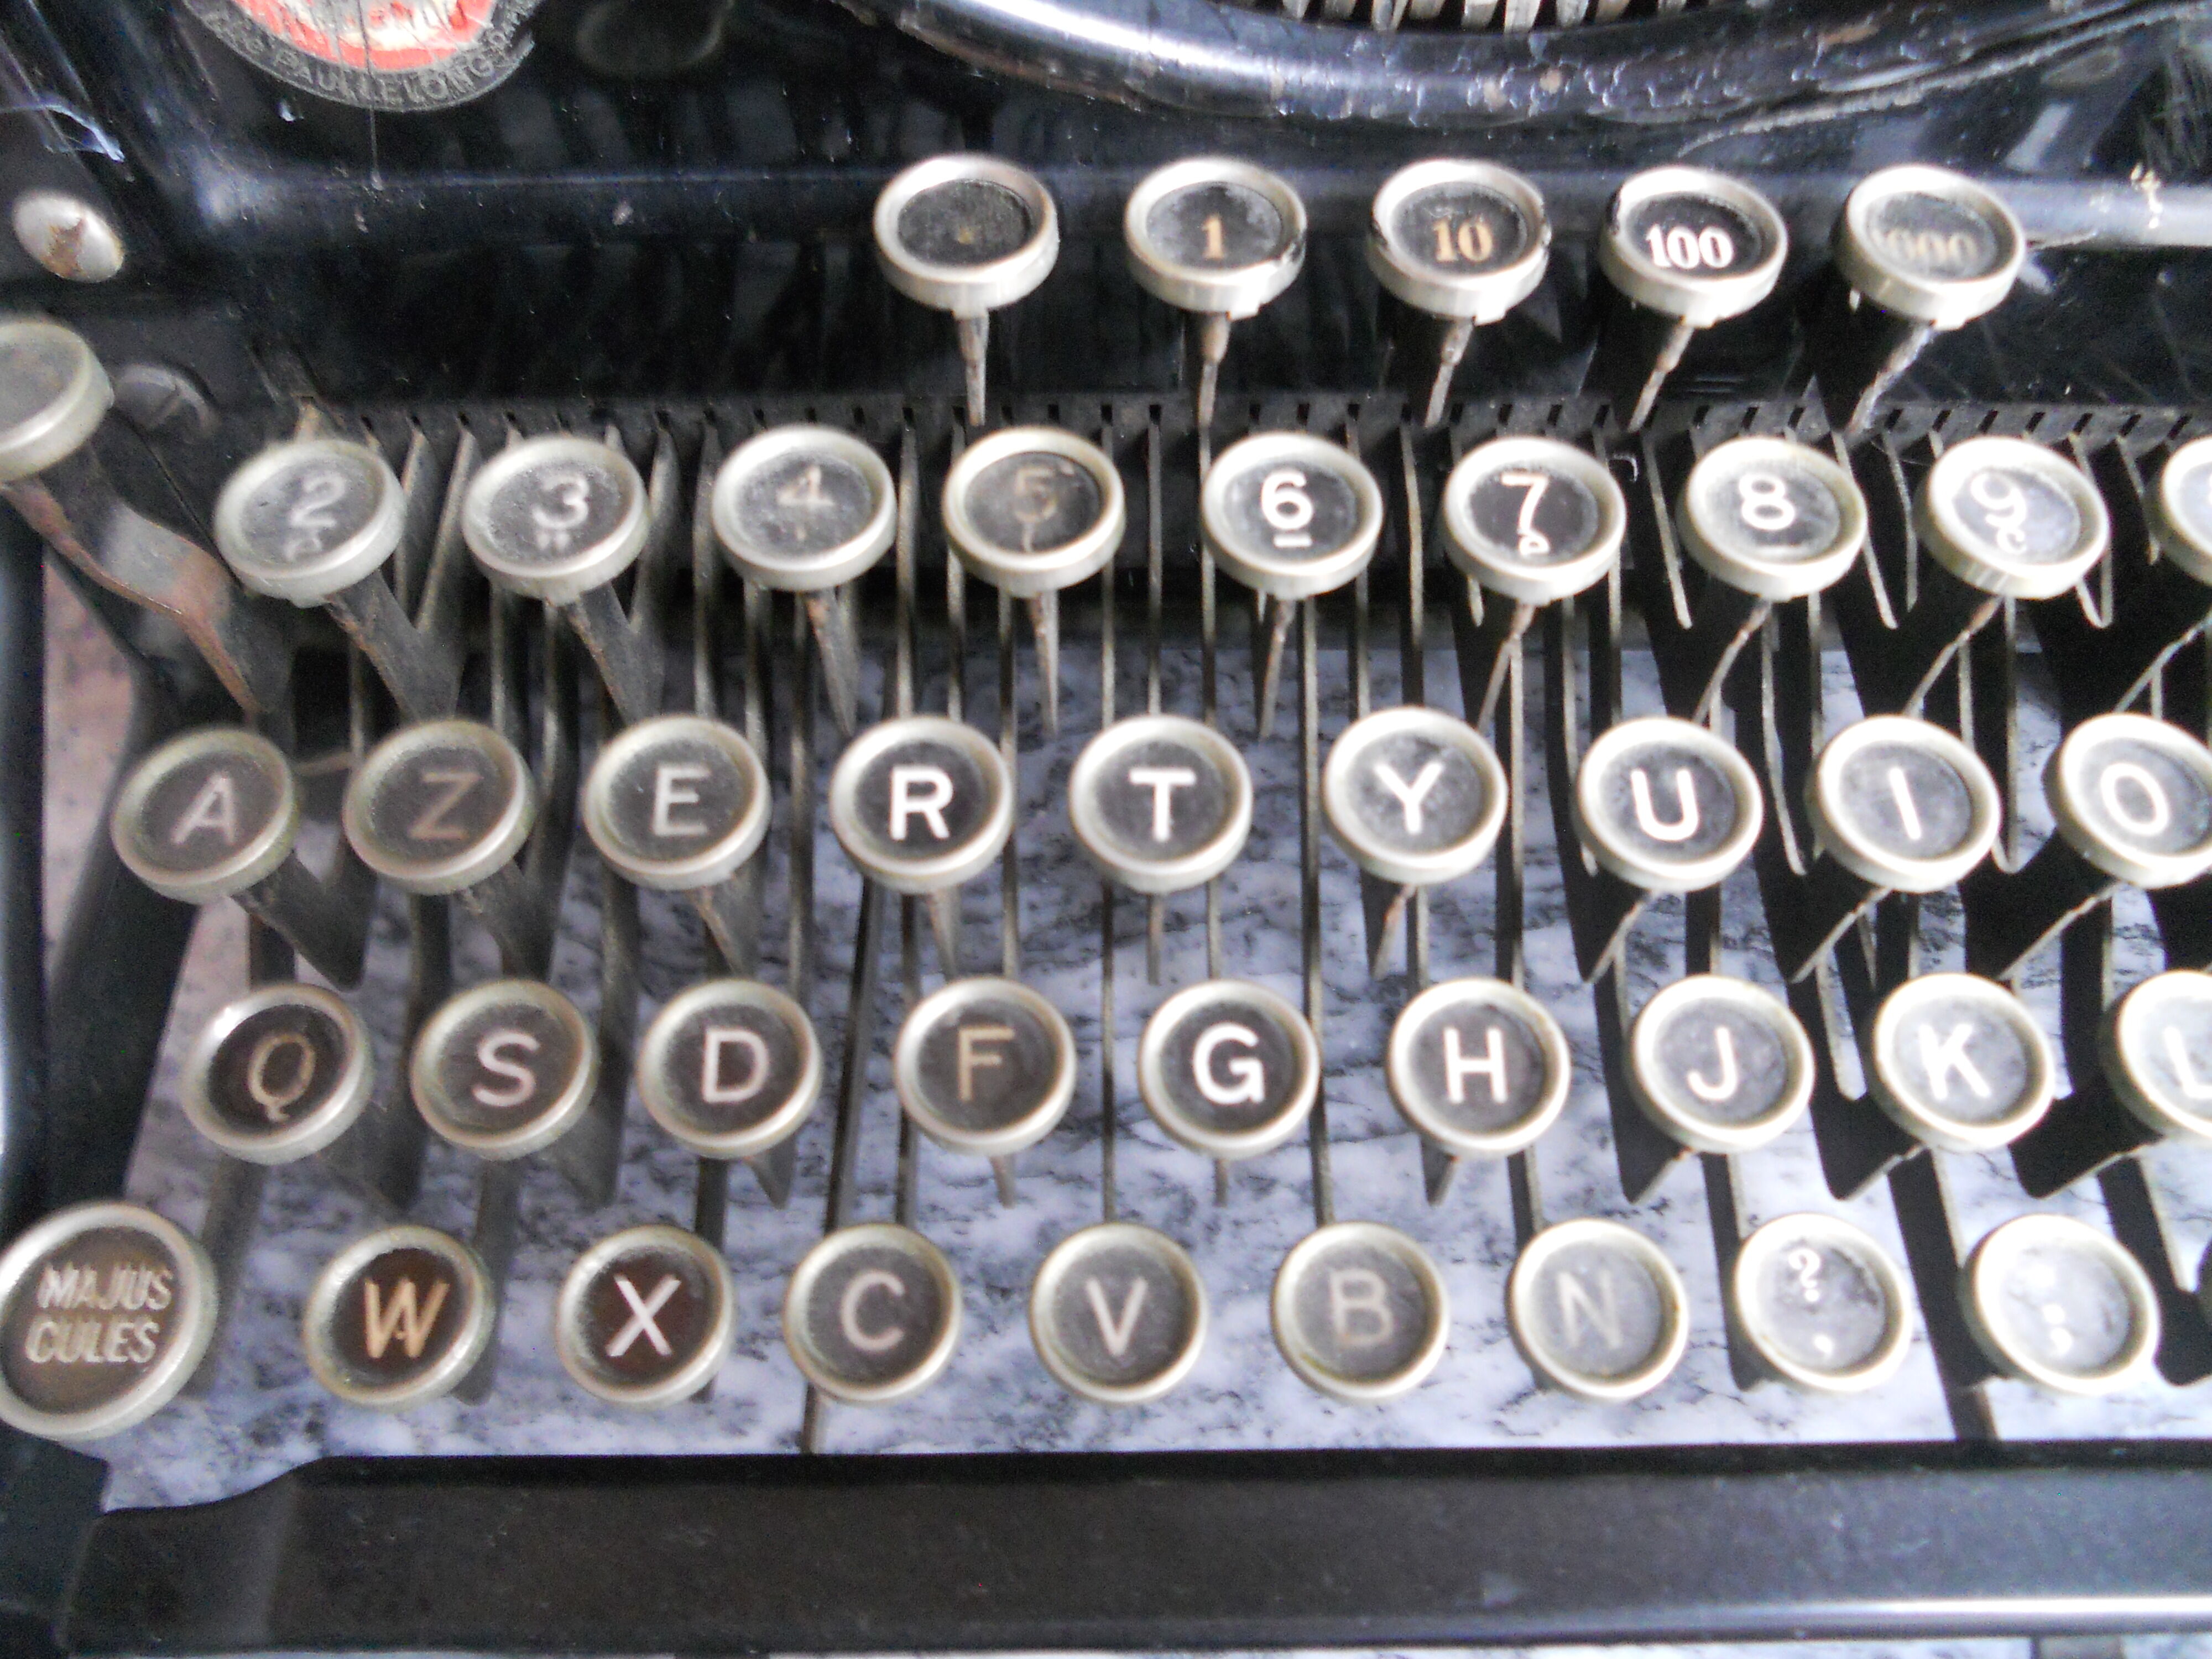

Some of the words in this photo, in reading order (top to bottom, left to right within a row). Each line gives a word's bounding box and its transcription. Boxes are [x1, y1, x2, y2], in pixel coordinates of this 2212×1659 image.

[1201, 213, 1226, 260] 1
[1433, 217, 1494, 262] 10
[1645, 223, 1735, 269] 100
[290, 471, 346, 527] 2
[532, 474, 590, 530] 3
[776, 466, 836, 509] 4
[1013, 468, 1059, 523] 5
[1260, 469, 1314, 531] 6
[1501, 473, 1548, 533] 7
[1739, 474, 1796, 531] 8
[1970, 471, 2027, 528] 9
[171, 772, 237, 845] A
[408, 772, 481, 841] Z
[652, 764, 710, 836] E
[889, 765, 954, 841] R
[1129, 766, 1196, 843] T
[1374, 761, 1444, 835] Y
[1630, 768, 1699, 842] U
[1887, 767, 1922, 842] I
[2100, 763, 2169, 838] O
[247, 1032, 316, 1123] Q
[472, 1030, 541, 1108] S
[702, 1026, 770, 1104] D
[957, 1024, 1016, 1102] F
[1191, 1022, 1265, 1104] G
[1442, 1026, 1509, 1104] H
[1687, 1026, 1739, 1101] J
[1917, 1022, 1991, 1101] K
[36, 1262, 173, 1310] MAJUS
[839, 1270, 906, 1352] C
[1329, 1267, 1395, 1348] B
[1557, 1269, 1624, 1351] N
[1788, 1248, 1820, 1303] ?
[24, 1317, 160, 1364] CULES
[363, 1277, 450, 1359] W
[605, 1274, 682, 1358] X
[1086, 1277, 1149, 1358] V
